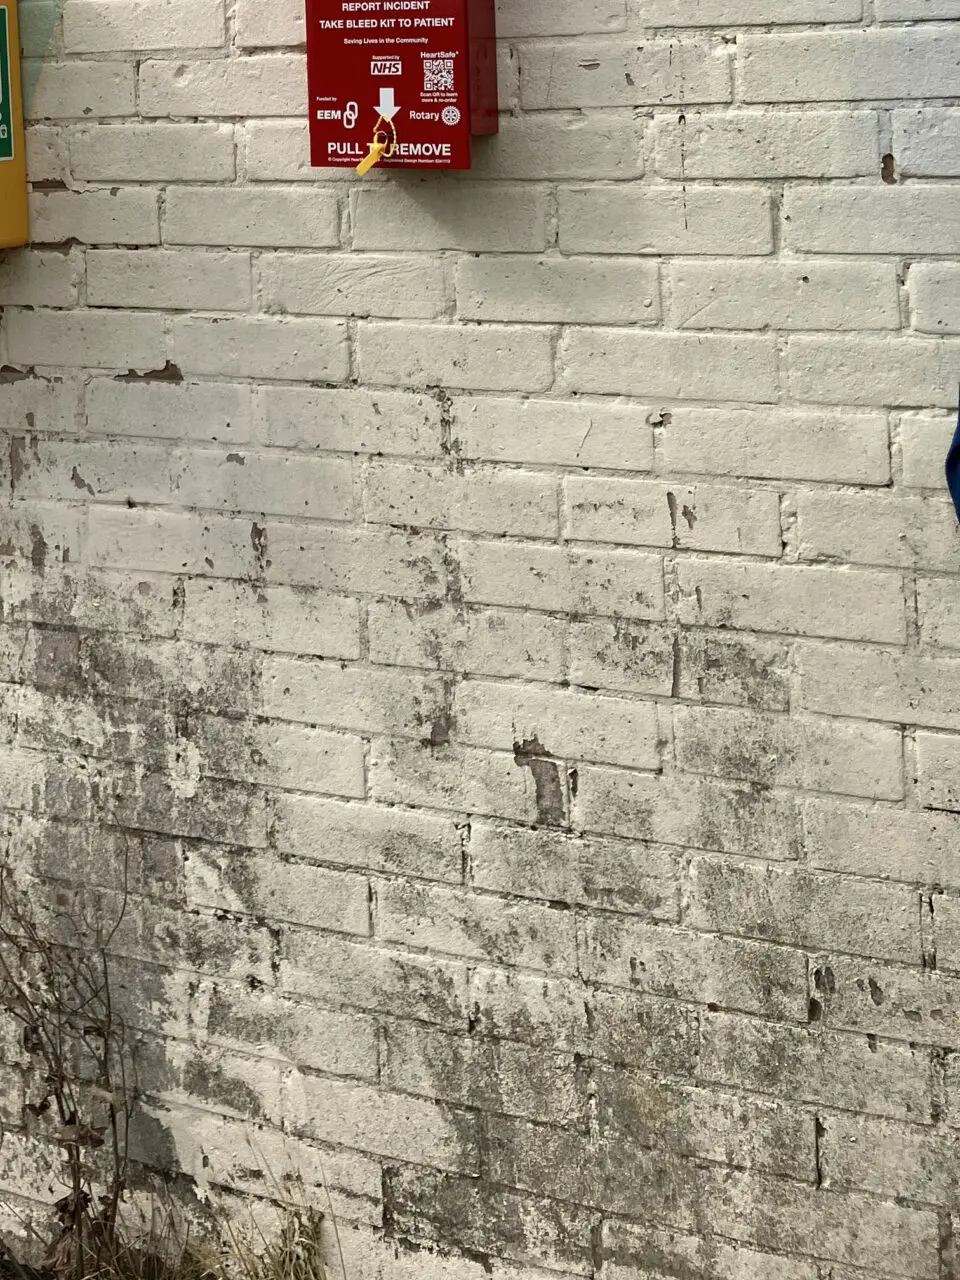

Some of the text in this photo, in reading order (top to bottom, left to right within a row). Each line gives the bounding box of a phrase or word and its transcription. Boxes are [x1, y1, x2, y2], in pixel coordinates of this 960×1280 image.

[342, 1, 430, 11] REPORT INCIDENT
[319, 17, 455, 29] TAKE BLEED KIT TO PATIENT
[396, 37, 428, 45] Community
[372, 62, 400, 74] NHS
[317, 110, 341, 119] EEM
[409, 110, 439, 121] Rotary
[327, 142, 364, 154] PULL
[390, 143, 451, 156] REMOVE
